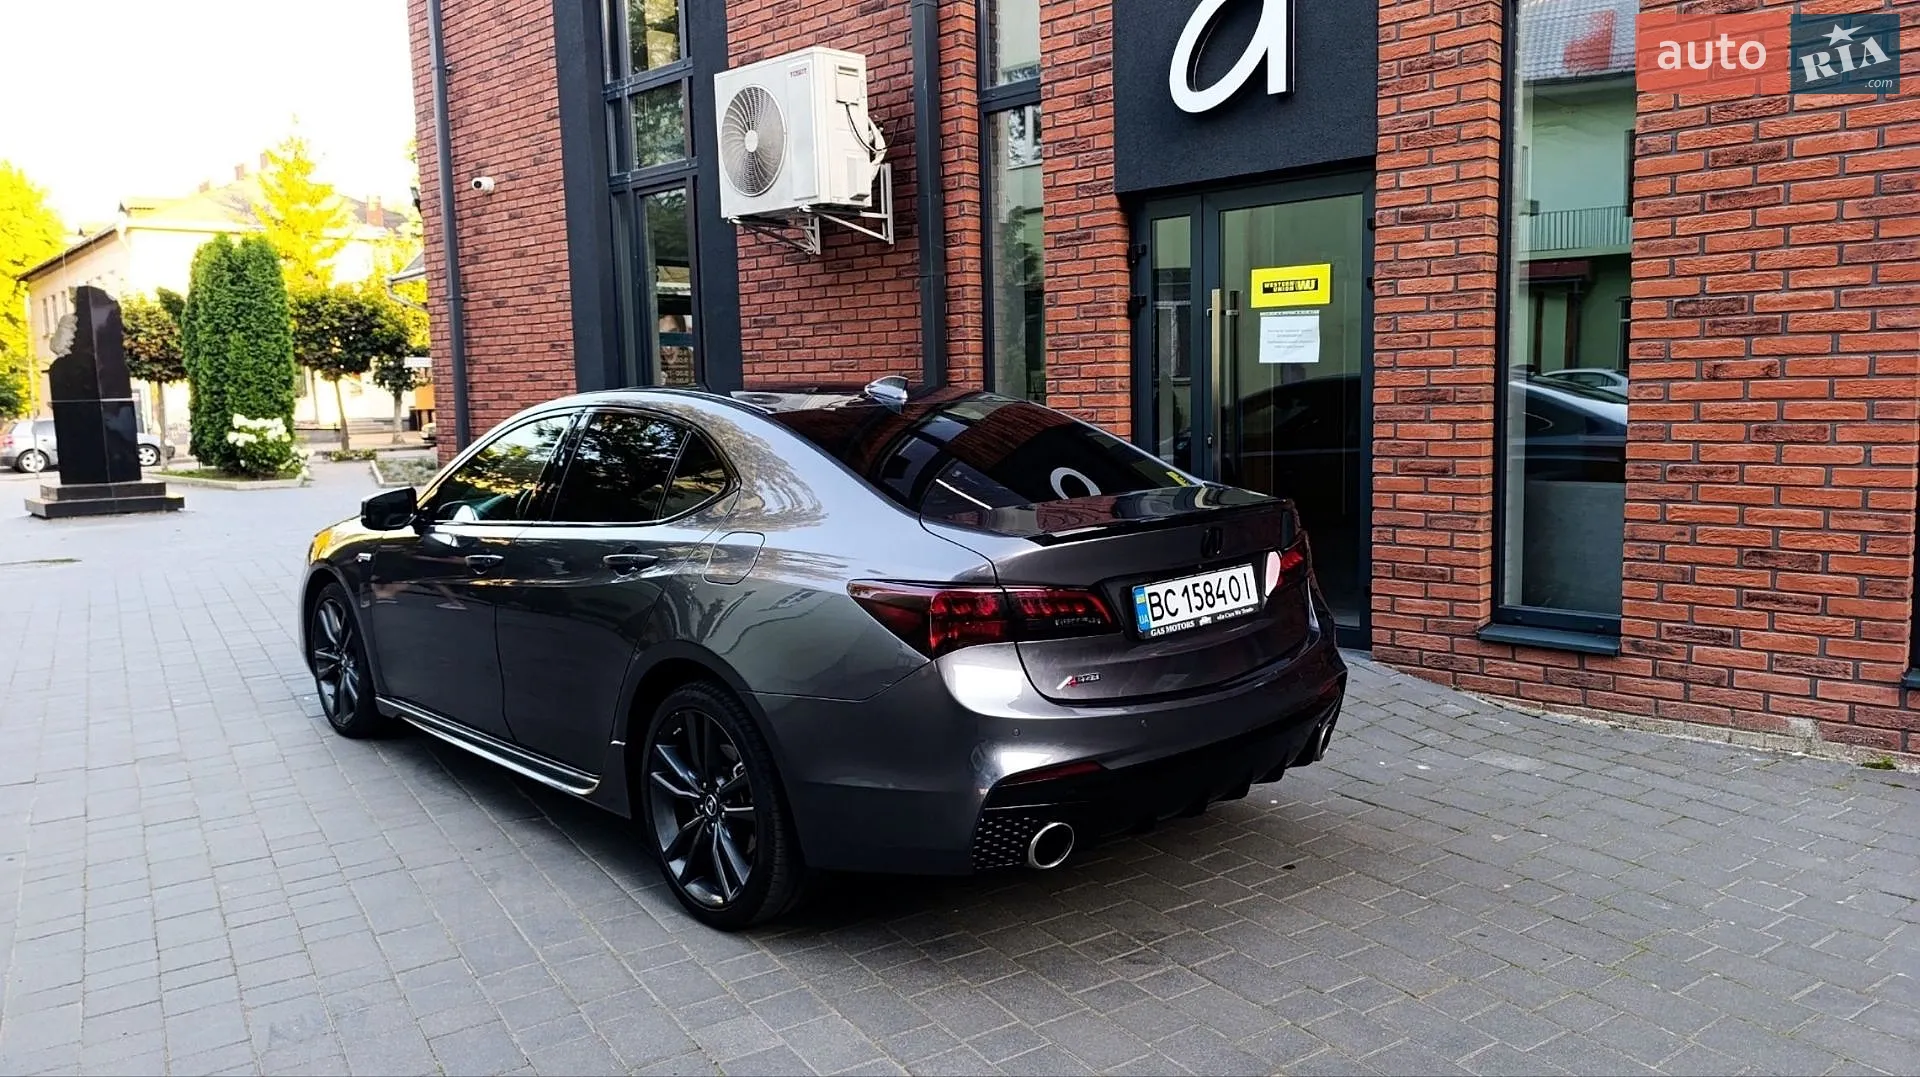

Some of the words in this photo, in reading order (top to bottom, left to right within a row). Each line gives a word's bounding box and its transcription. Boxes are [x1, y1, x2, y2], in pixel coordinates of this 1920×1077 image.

[1264, 280, 1294, 288] WESTERN
[1150, 627, 1165, 637] GAS
[1165, 620, 1195, 634] MOTORS
